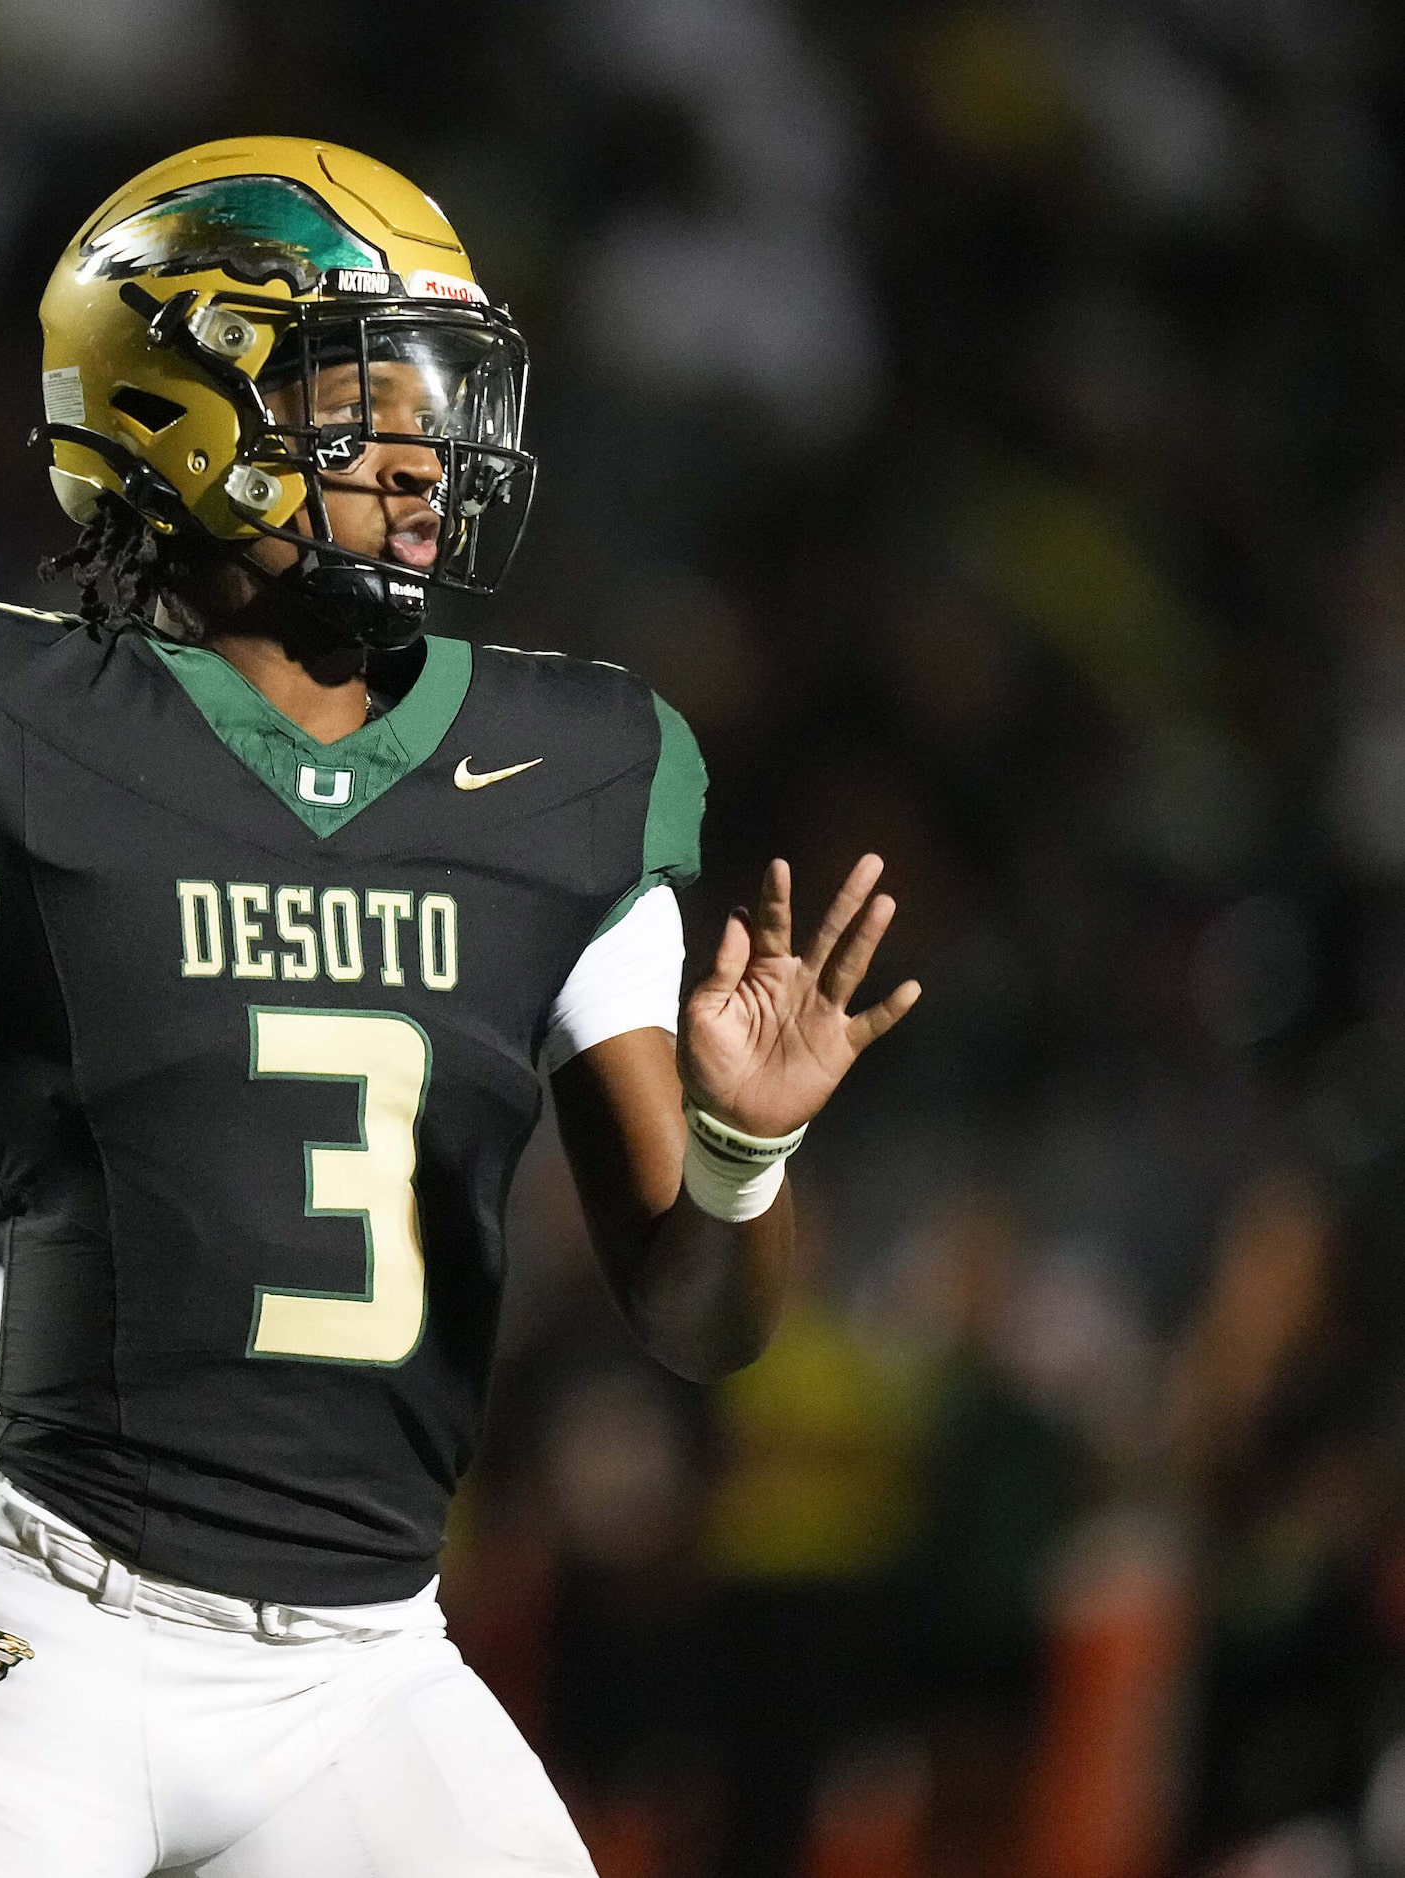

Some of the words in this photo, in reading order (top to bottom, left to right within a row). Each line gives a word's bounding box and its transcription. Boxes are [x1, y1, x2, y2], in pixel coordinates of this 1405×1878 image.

[338, 270, 391, 295] NXTRND
[297, 763, 352, 806] U
[176, 878, 459, 992] DESOTO
[245, 1005, 433, 1369] 3
